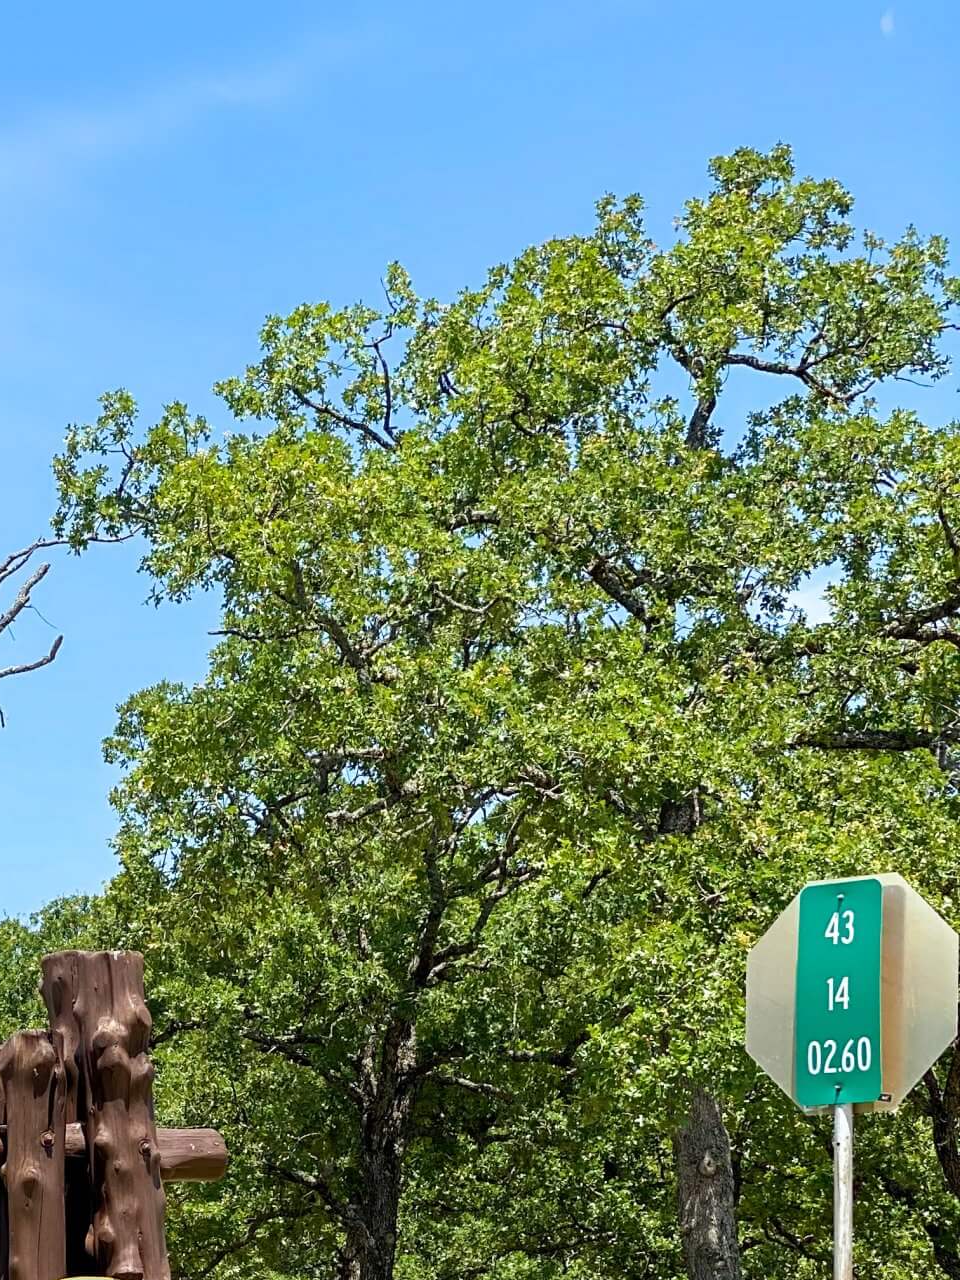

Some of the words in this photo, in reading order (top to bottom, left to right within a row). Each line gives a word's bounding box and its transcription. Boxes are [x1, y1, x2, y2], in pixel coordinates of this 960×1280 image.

[825, 910, 855, 945] 43
[826, 976, 850, 1011] 14
[807, 1036, 872, 1075] 02.60
